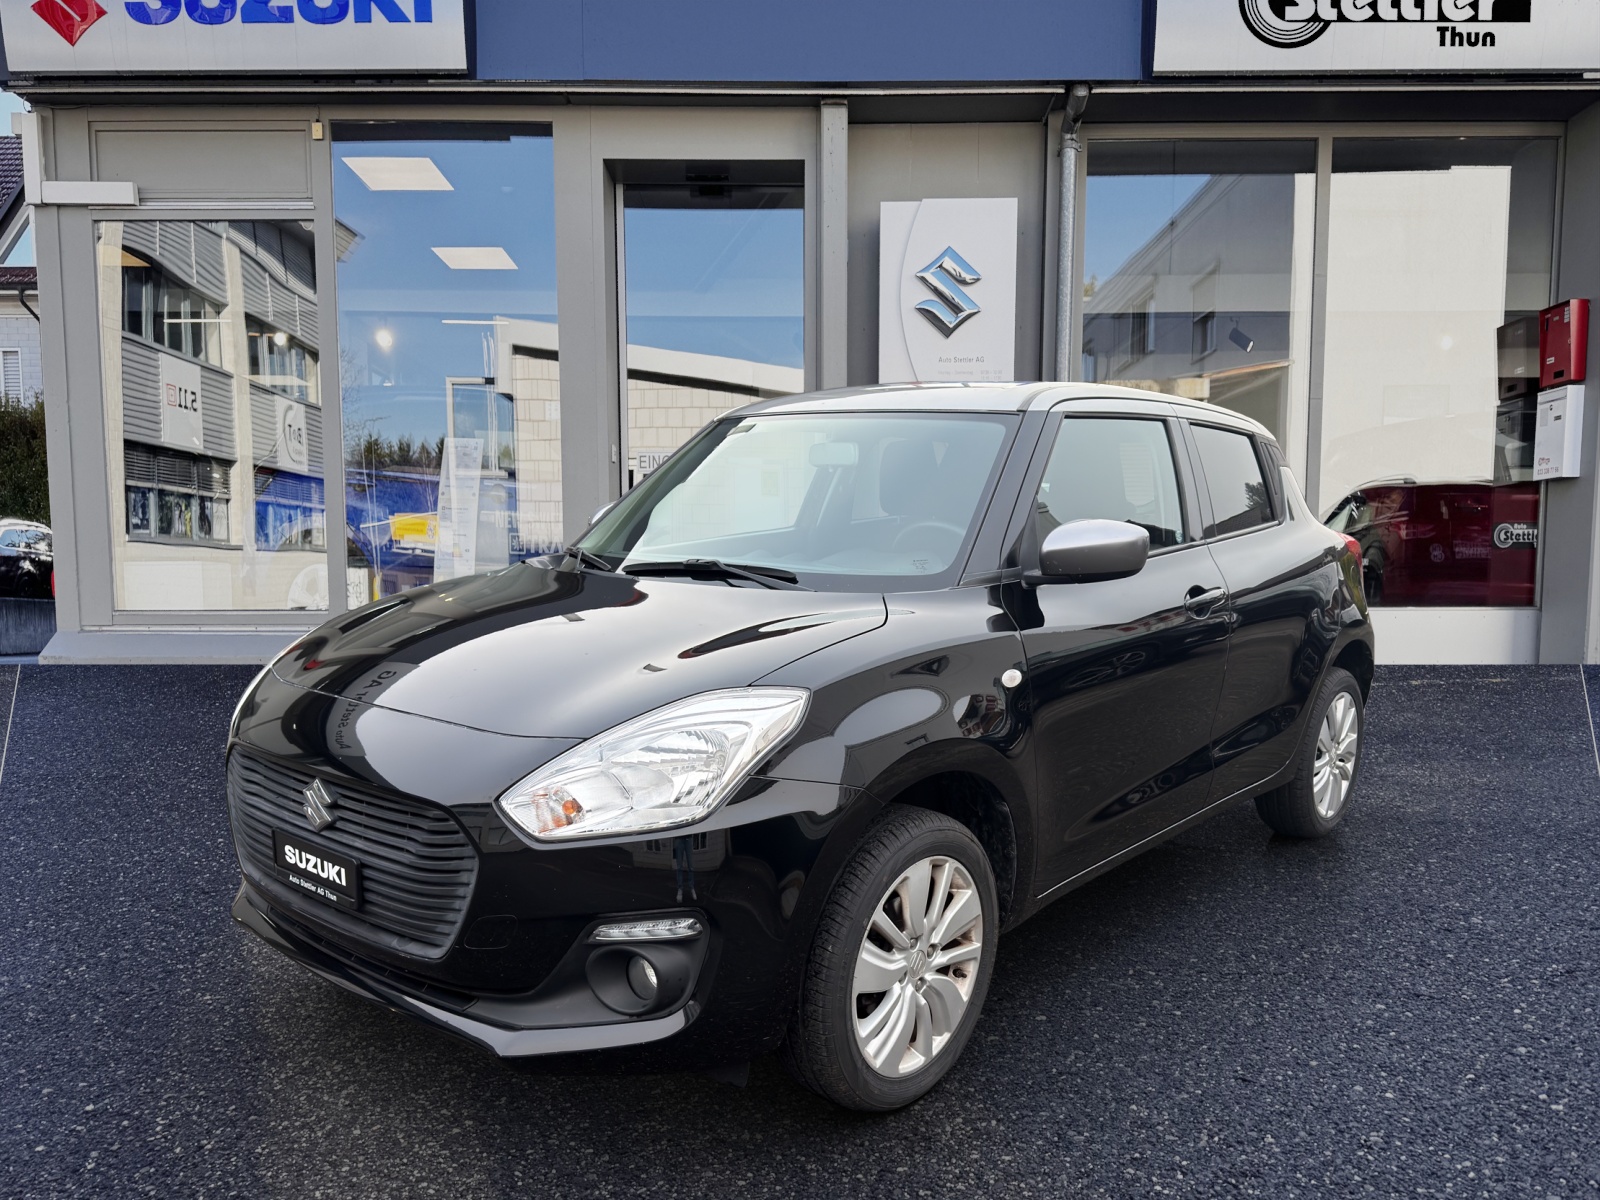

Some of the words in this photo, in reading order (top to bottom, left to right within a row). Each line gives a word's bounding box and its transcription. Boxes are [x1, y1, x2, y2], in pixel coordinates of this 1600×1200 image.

[1436, 26, 1496, 47] Thun
[284, 844, 346, 887] SUZUKI
[289, 874, 300, 885] Auto
[300, 879, 317, 892] Stettler
[317, 887, 325, 896] AG
[325, 890, 337, 902] Thun
